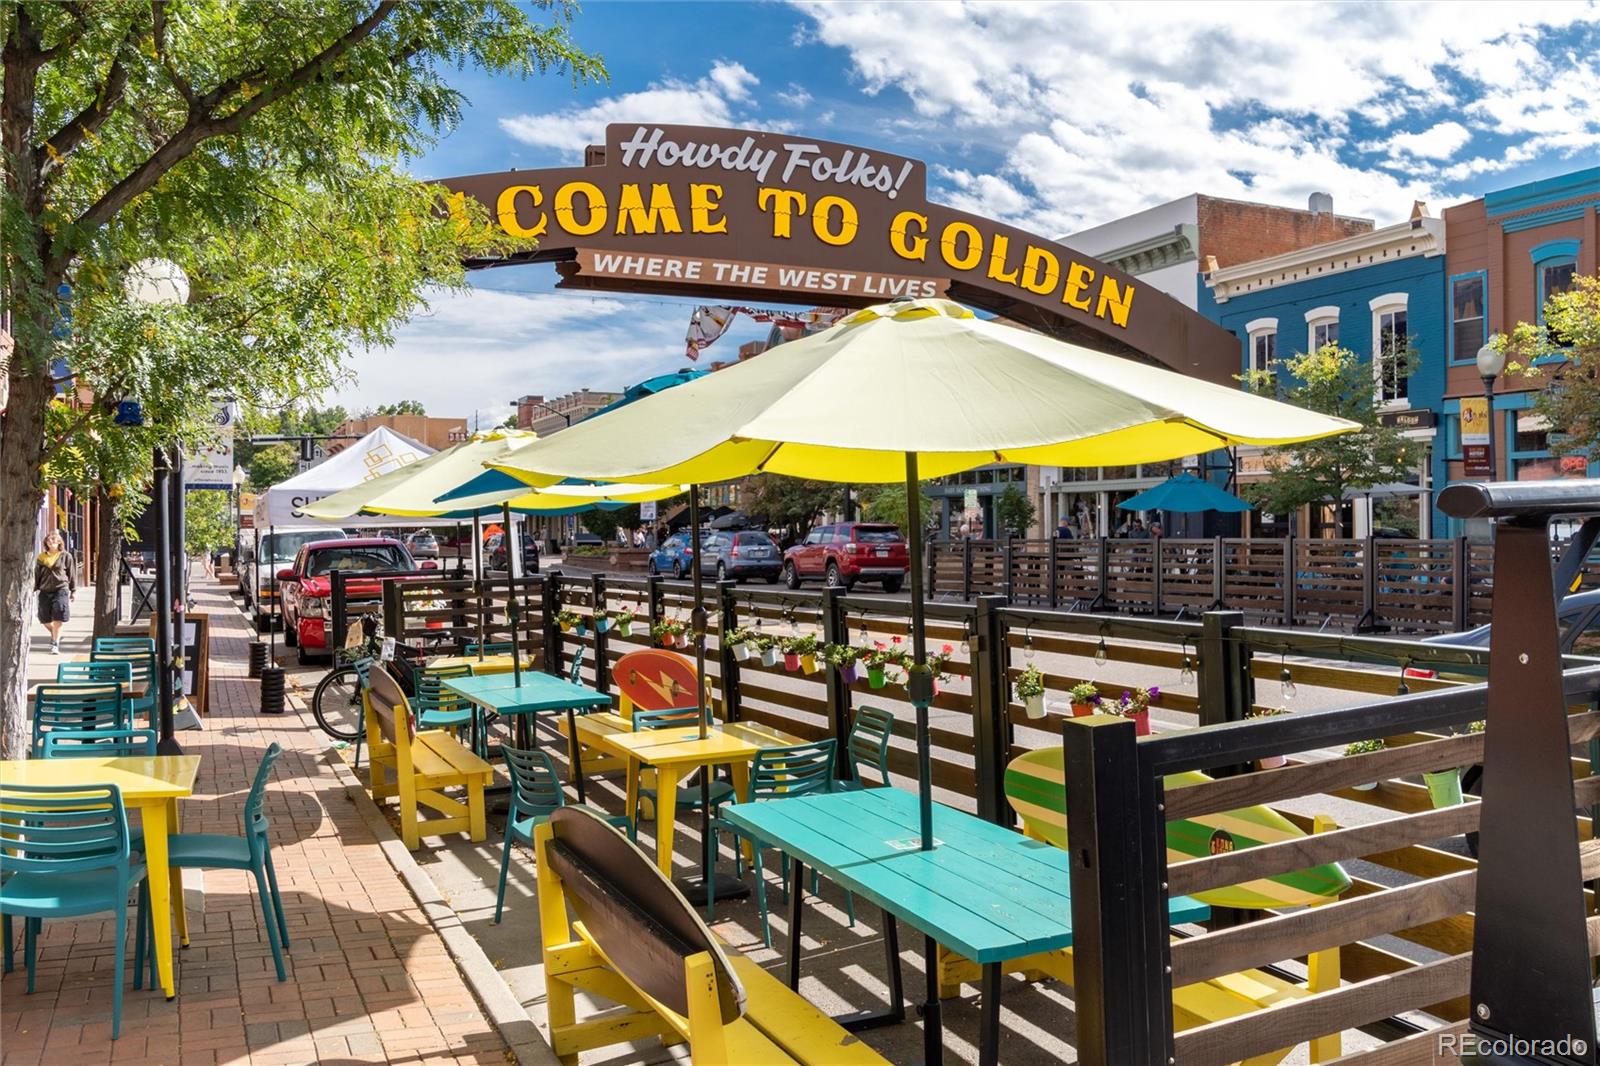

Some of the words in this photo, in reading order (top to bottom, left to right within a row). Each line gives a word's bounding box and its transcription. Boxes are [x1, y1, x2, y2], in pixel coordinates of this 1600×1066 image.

[620, 126, 778, 183] Howdy
[782, 143, 913, 199] Folks!
[448, 180, 728, 242] COME
[758, 187, 858, 246] TO
[889, 210, 1136, 329] GOLDEN
[593, 253, 703, 280] WHERE
[712, 262, 768, 284] THE
[778, 268, 856, 292] WEST
[863, 276, 937, 298] LIVES
